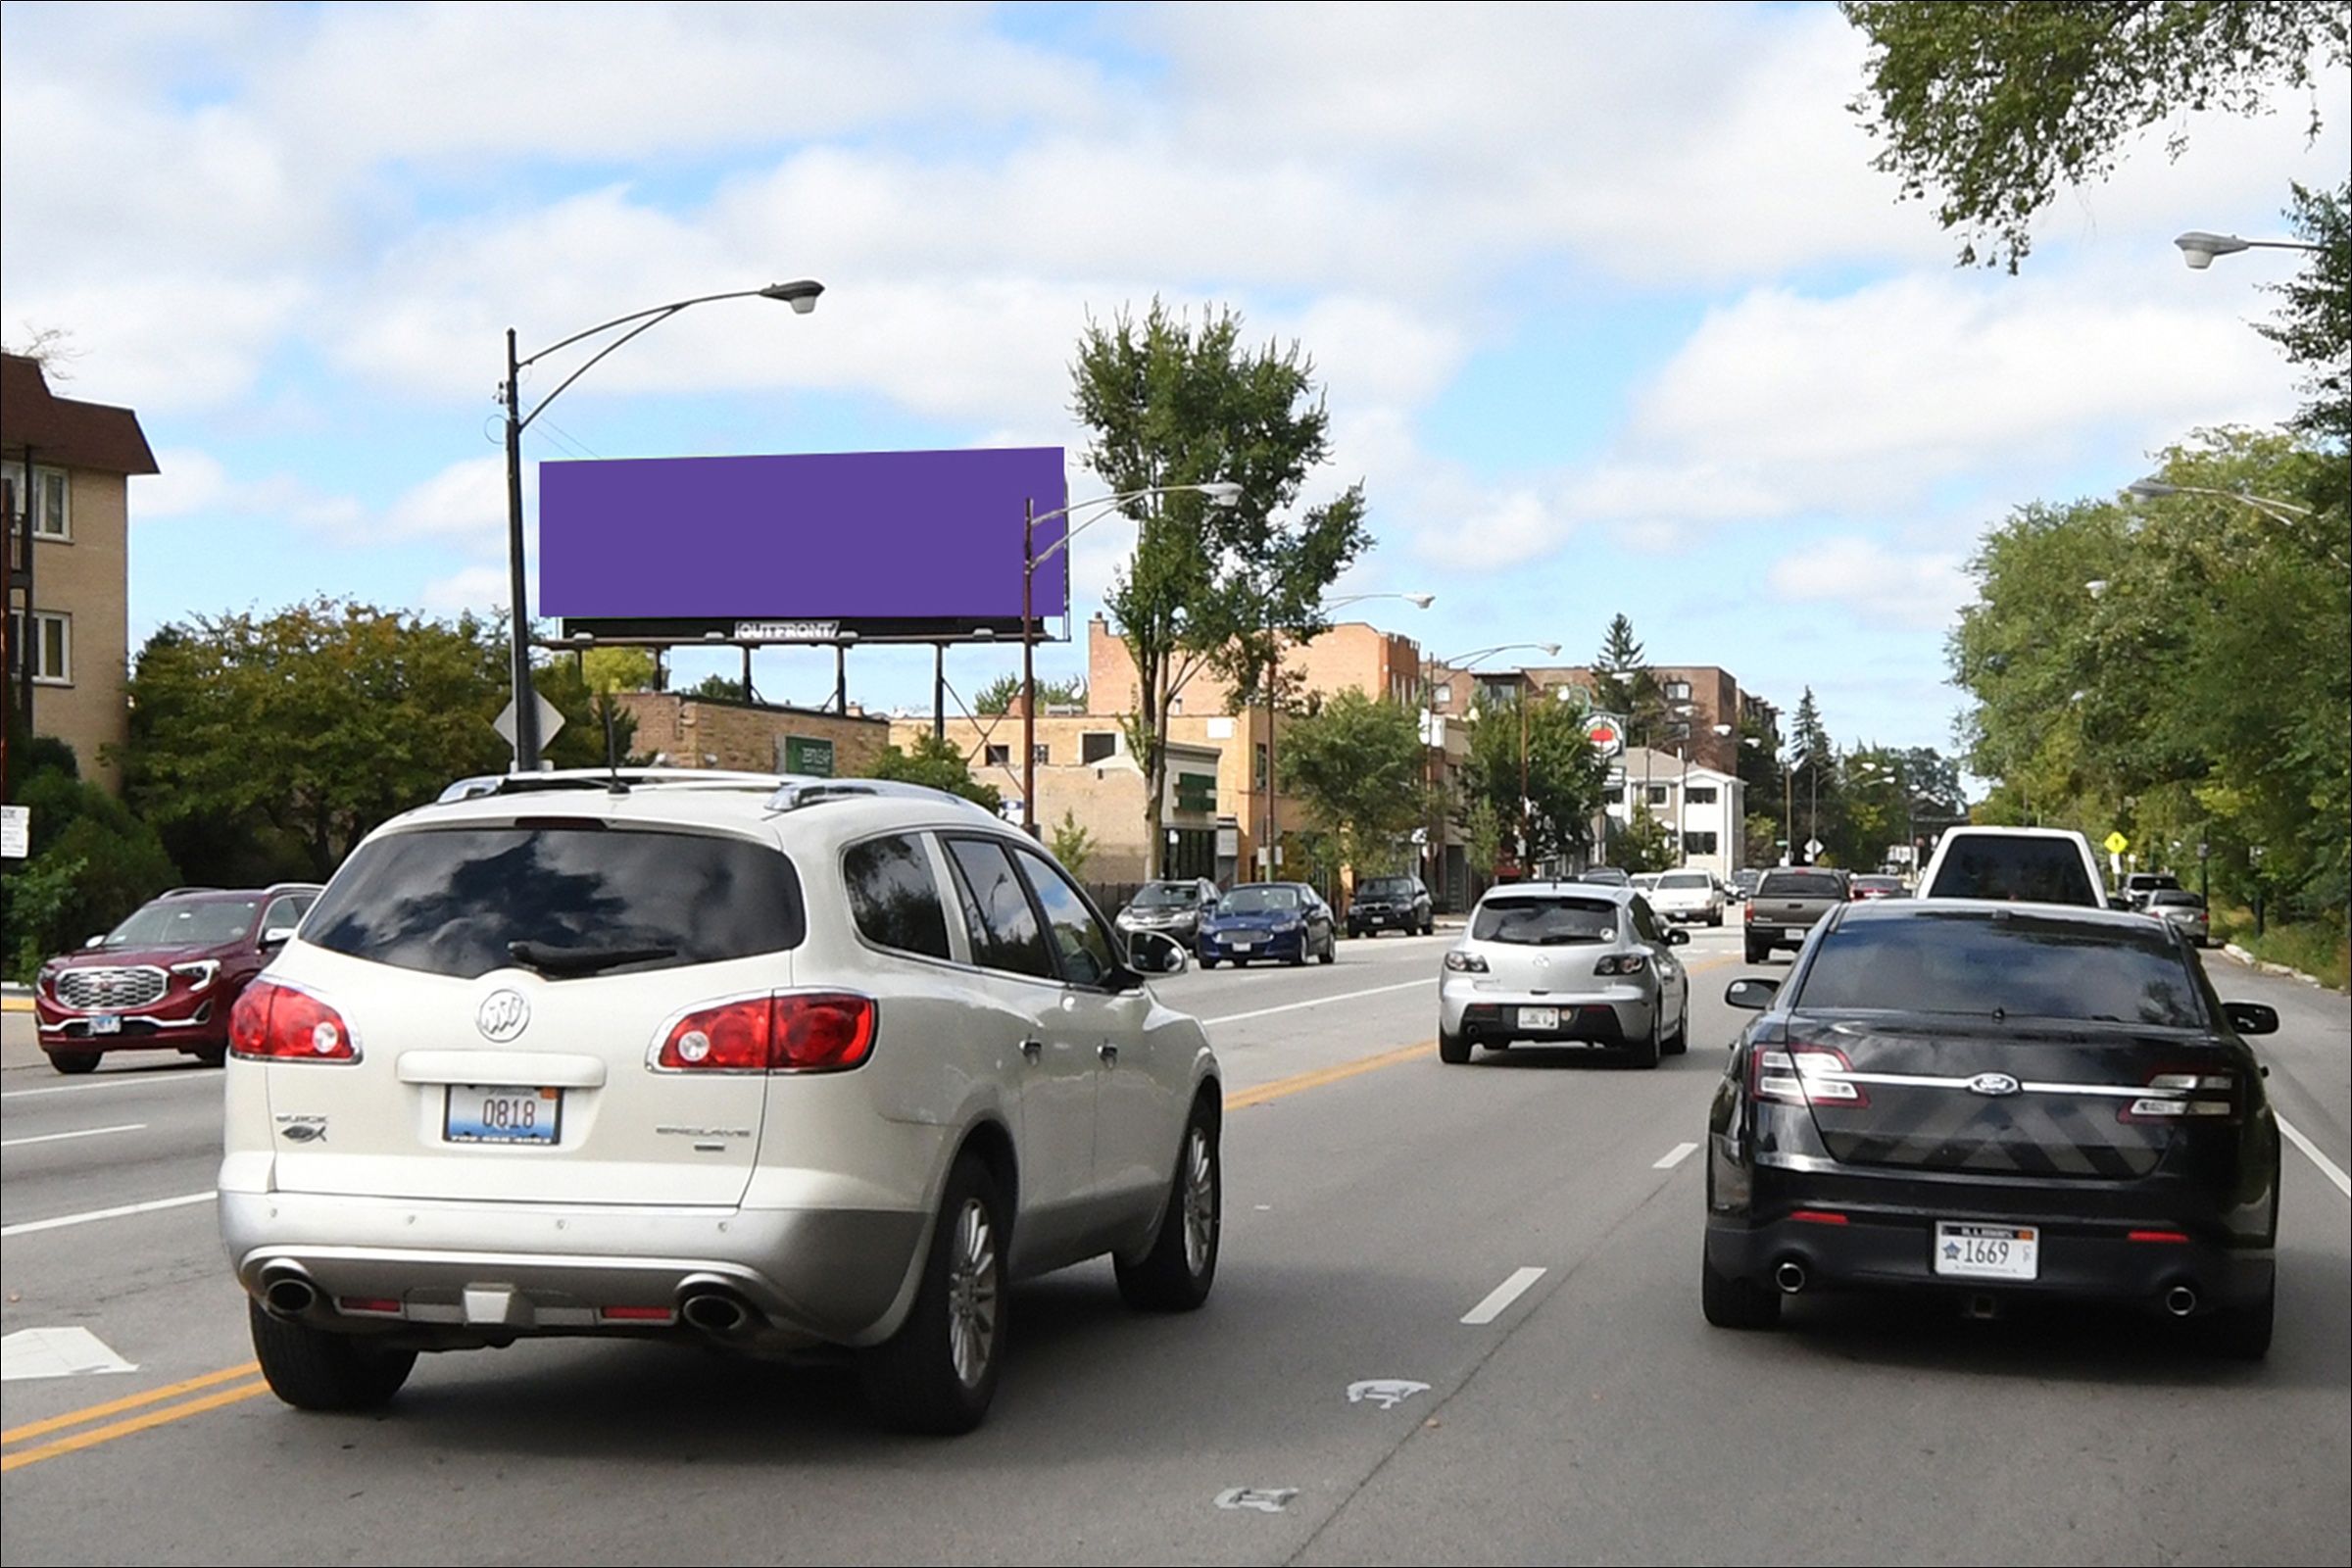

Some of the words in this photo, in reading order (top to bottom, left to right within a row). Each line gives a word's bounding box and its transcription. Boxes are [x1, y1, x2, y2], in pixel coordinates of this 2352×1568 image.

[482, 1098, 536, 1129] 0818
[656, 1127, 751, 1138] ENCLAVE
[1964, 1239, 2010, 1265] 1669
